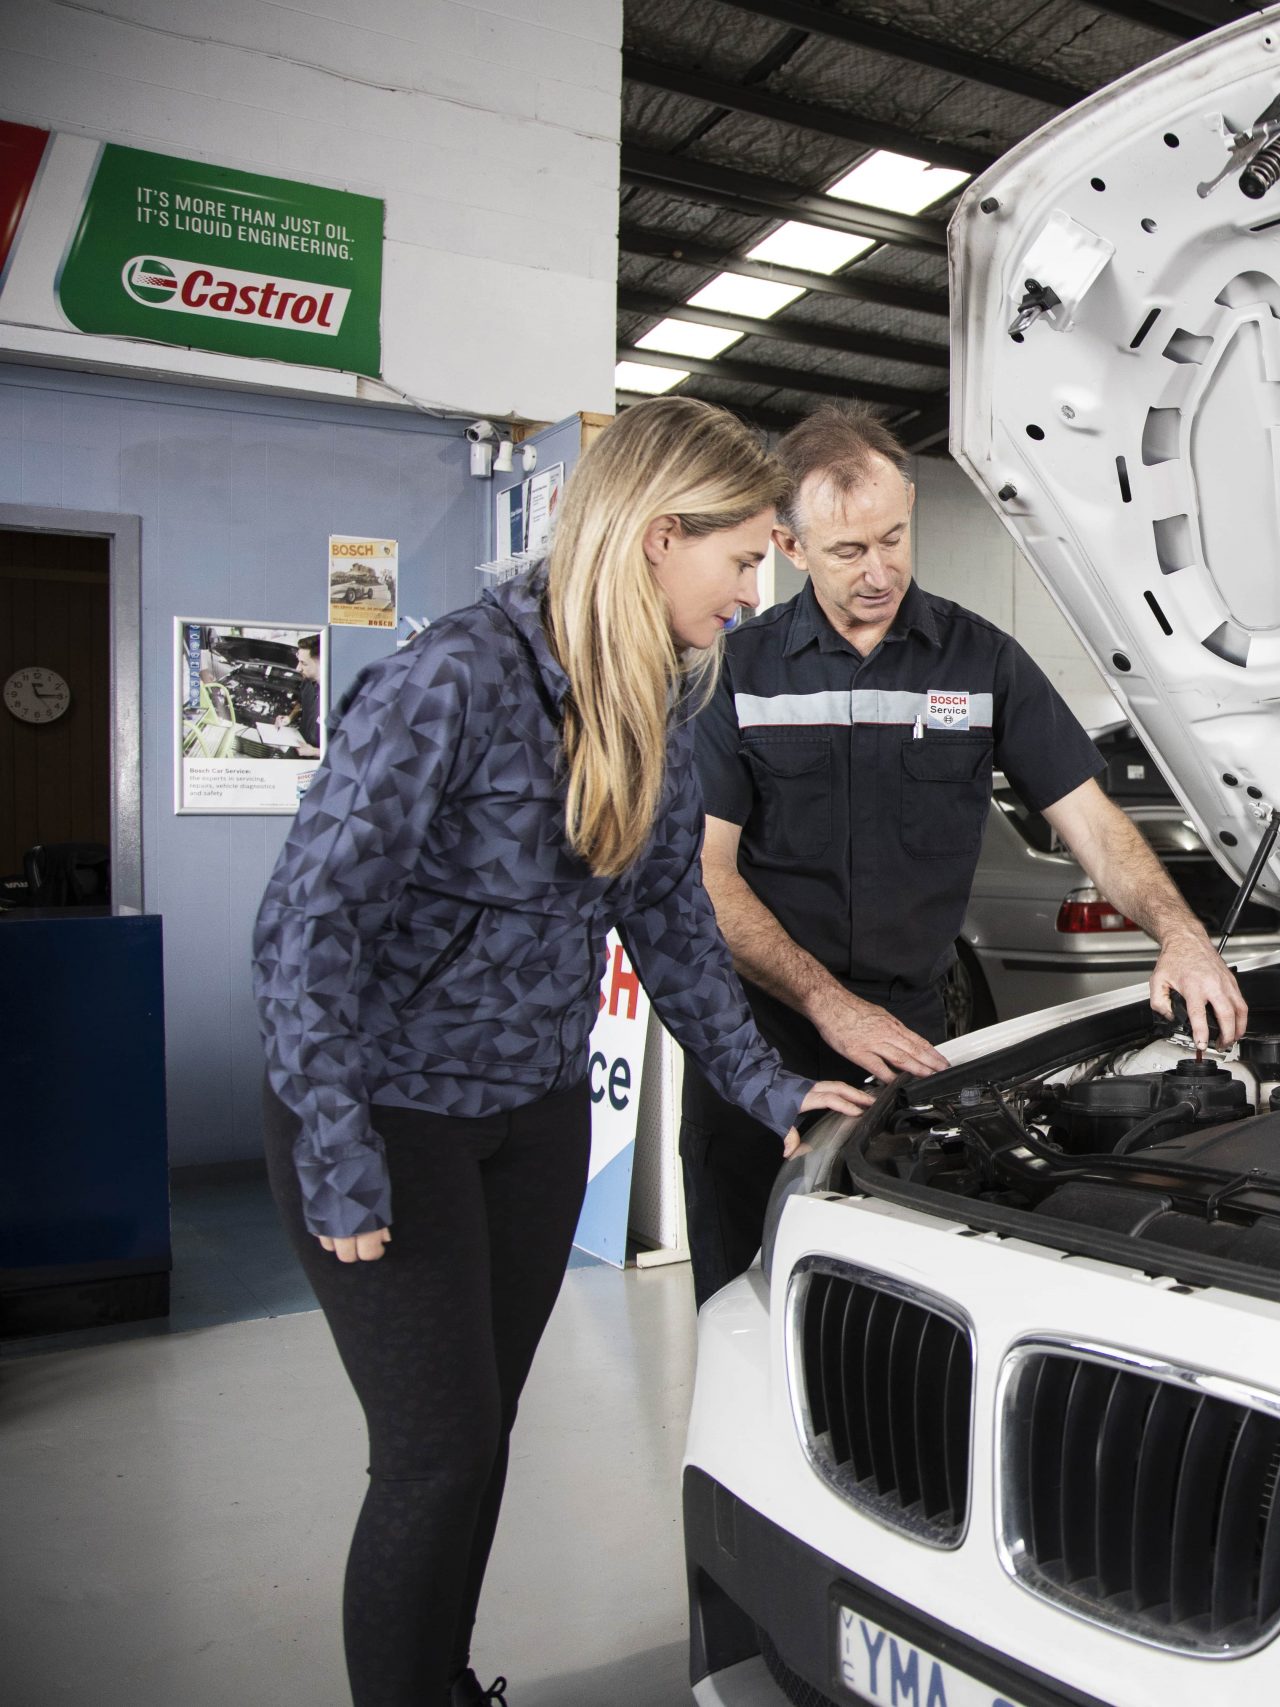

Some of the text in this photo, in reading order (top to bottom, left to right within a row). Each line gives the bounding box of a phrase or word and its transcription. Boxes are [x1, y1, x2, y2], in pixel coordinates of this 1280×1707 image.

[137, 186, 355, 243] IT'S MORE THAN JUST OIL.
[137, 206, 354, 261] IT'S LIQUID ENGINEERING.
[181, 269, 335, 328] Castrol
[332, 544, 373, 556] BOSCH
[930, 695, 967, 705] BOSCH
[930, 705, 967, 715] Service
